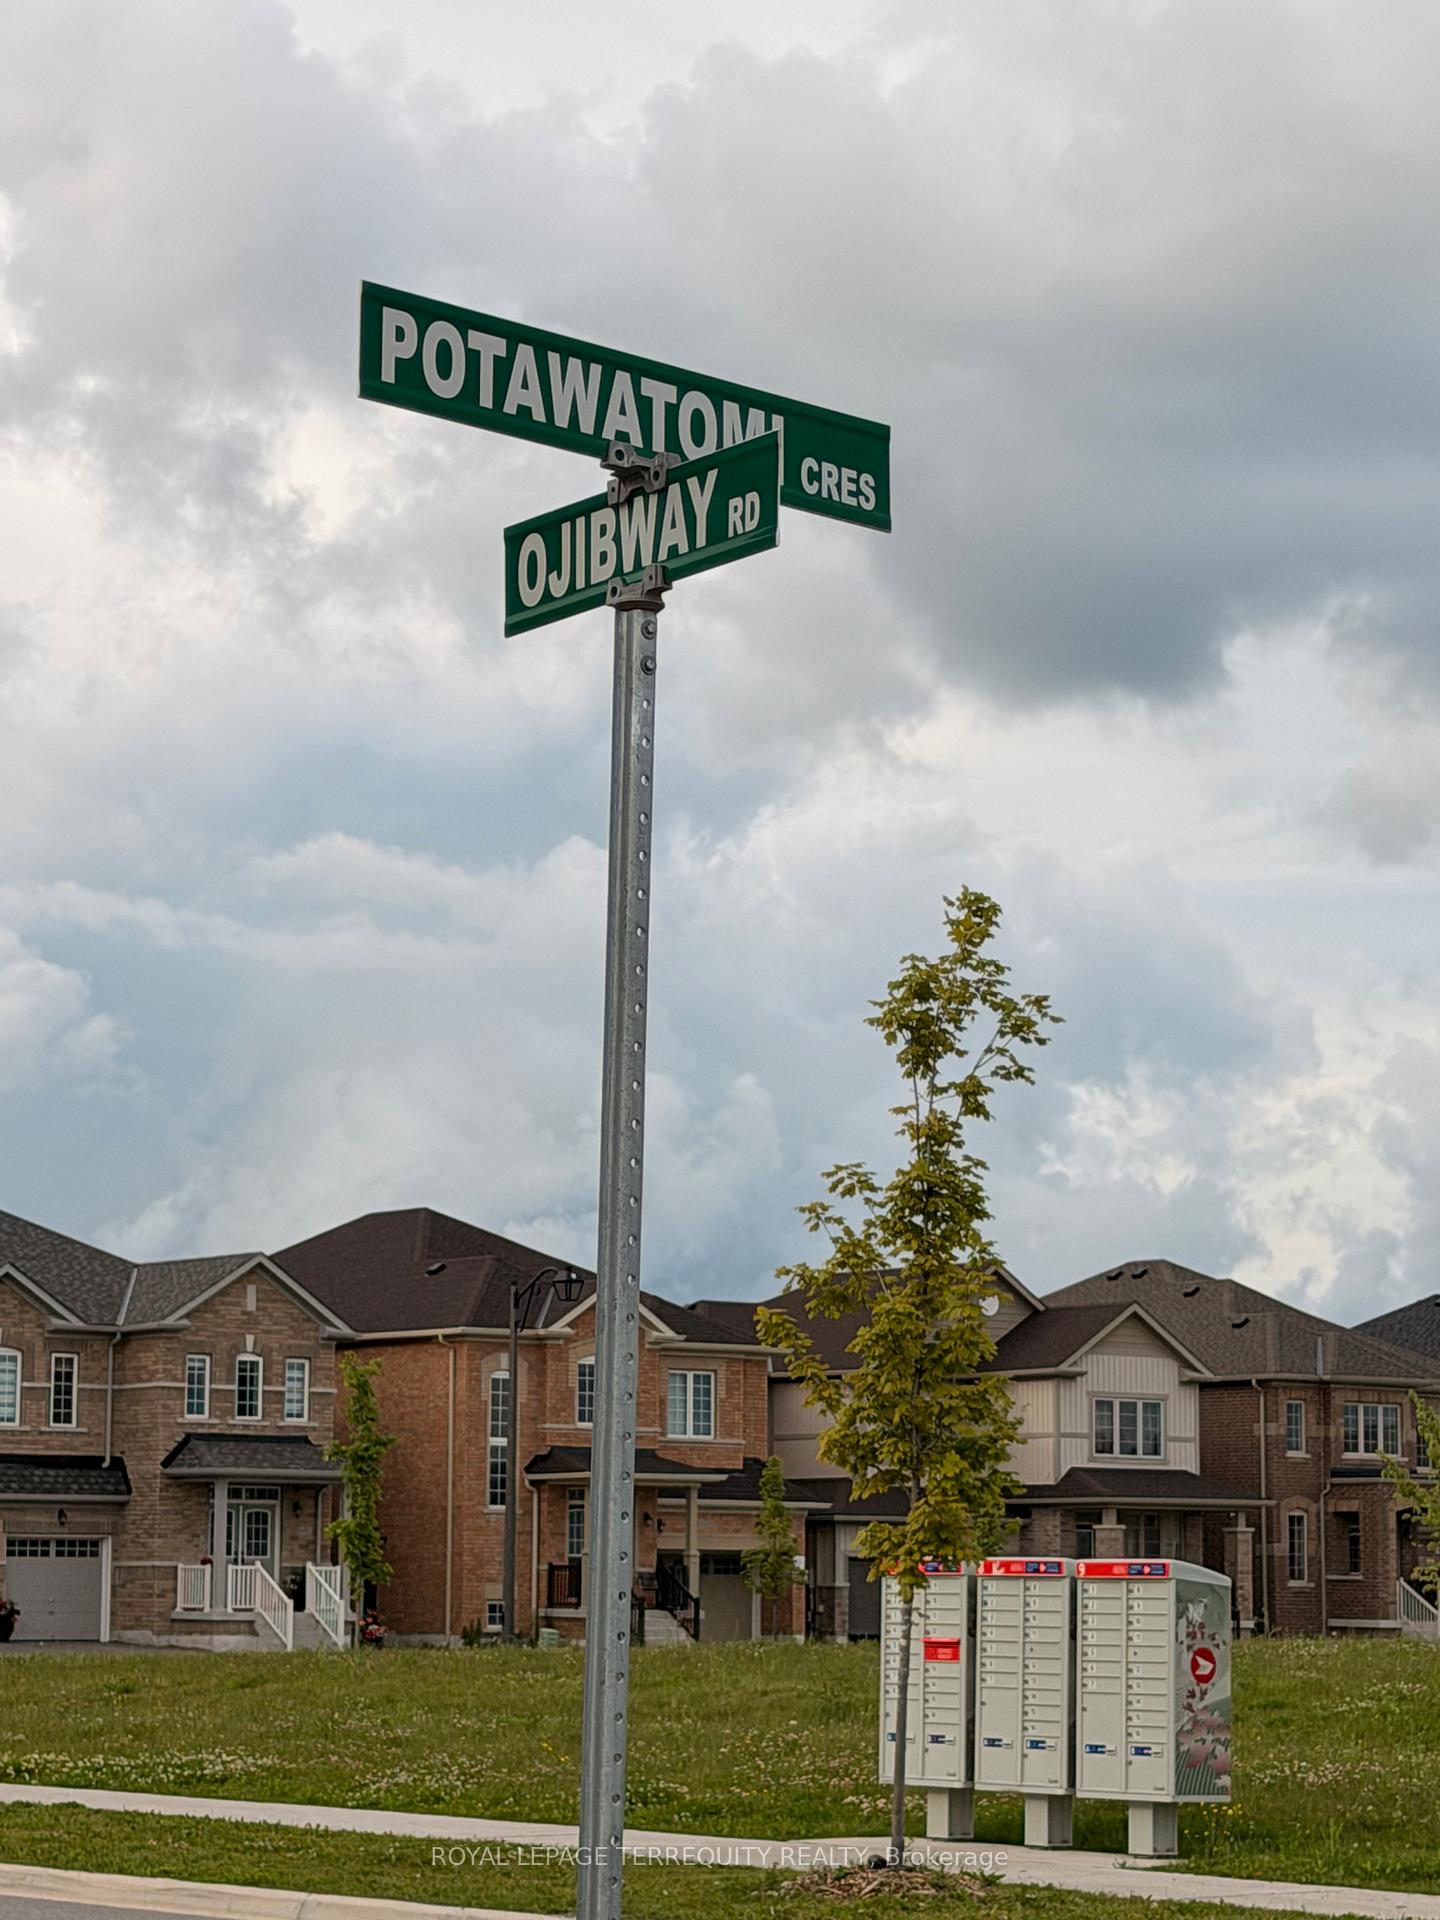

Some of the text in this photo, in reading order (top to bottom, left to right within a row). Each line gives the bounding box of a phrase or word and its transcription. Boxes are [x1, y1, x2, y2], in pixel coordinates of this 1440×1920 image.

[801, 456, 876, 511] CRES
[518, 468, 760, 608] OJIBWAY RD
